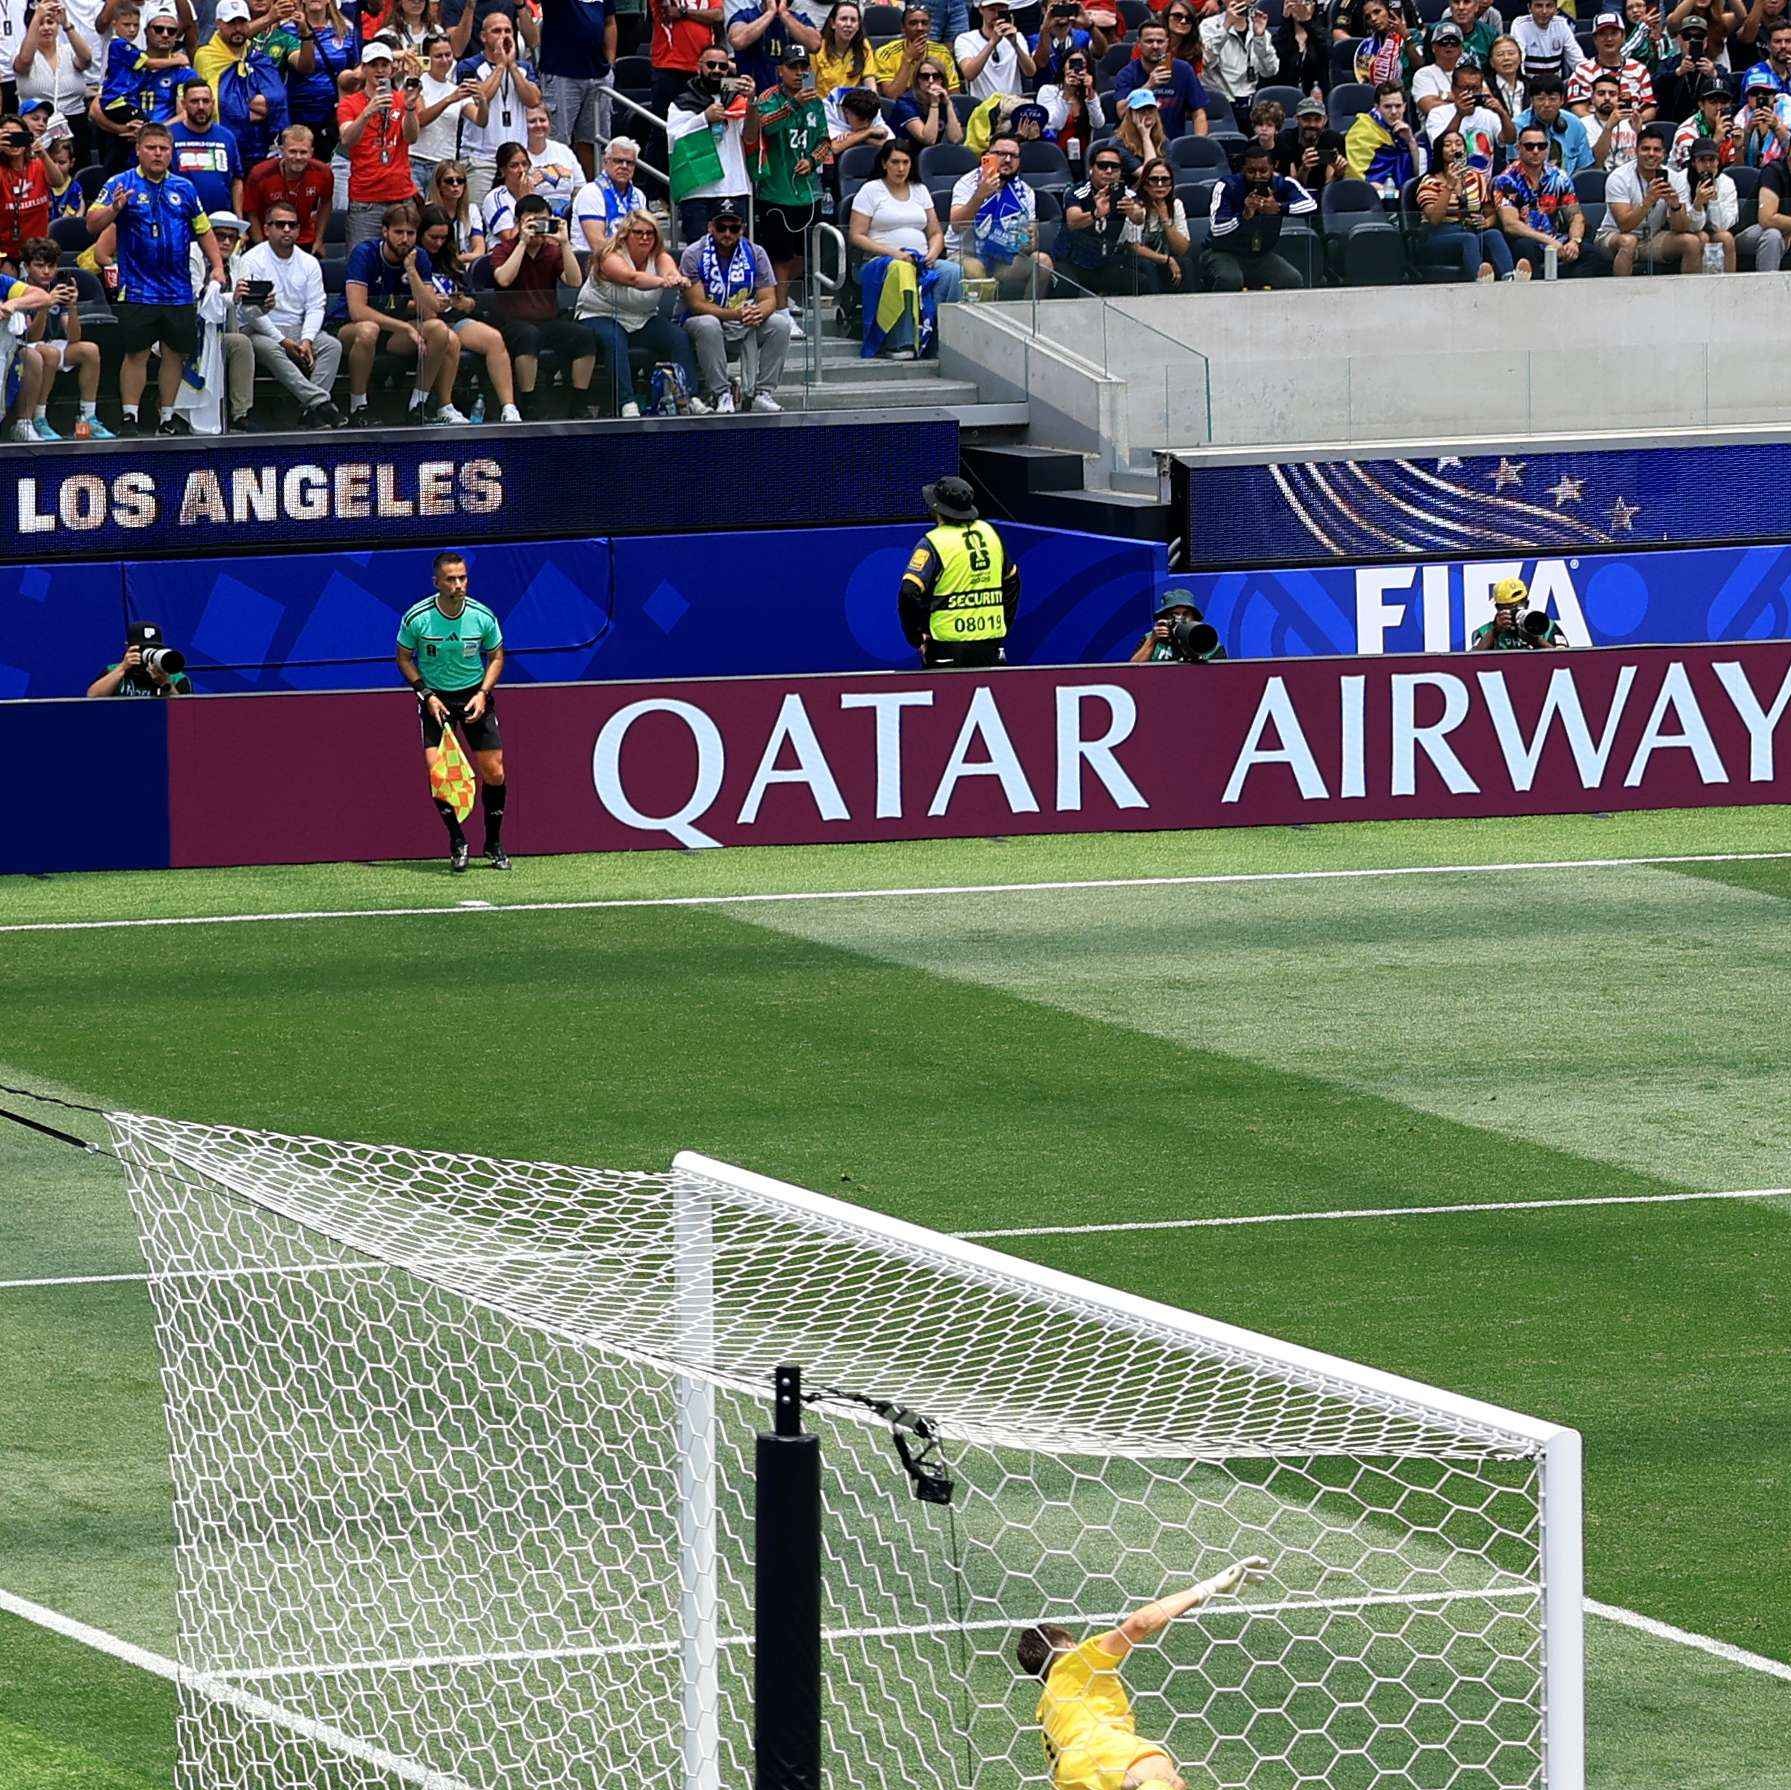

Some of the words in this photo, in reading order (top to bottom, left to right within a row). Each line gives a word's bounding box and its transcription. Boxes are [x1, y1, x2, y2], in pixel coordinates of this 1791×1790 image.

[18, 472, 156, 533] LOS
[179, 459, 502, 525] ANGELES
[948, 590, 1002, 608] SECURIT
[954, 614, 1001, 632] 08019
[1356, 560, 1593, 654] FIFA
[592, 685, 1149, 848] QATAR
